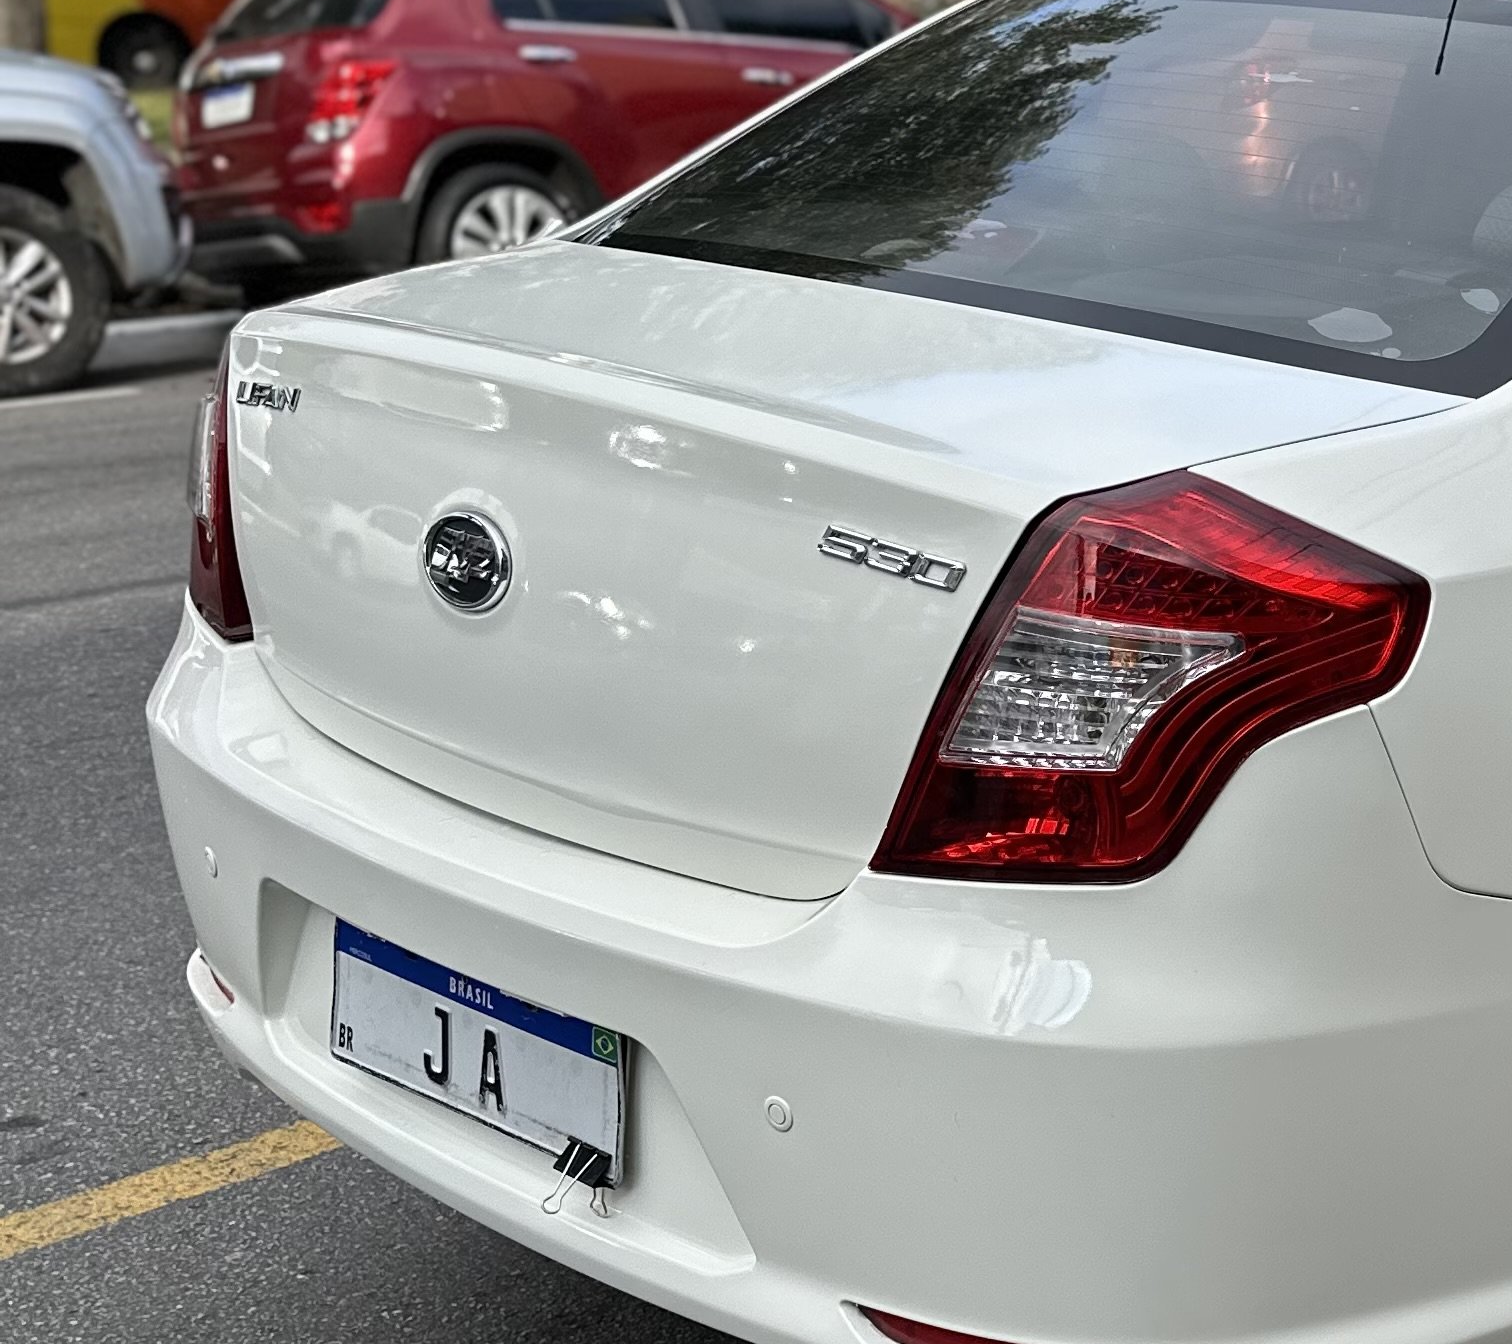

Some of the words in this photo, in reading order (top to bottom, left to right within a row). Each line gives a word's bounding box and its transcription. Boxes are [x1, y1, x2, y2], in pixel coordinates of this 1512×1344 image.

[816, 524, 968, 593] 530
[449, 976, 494, 1010] BRASIL
[338, 1022, 353, 1053] BR
